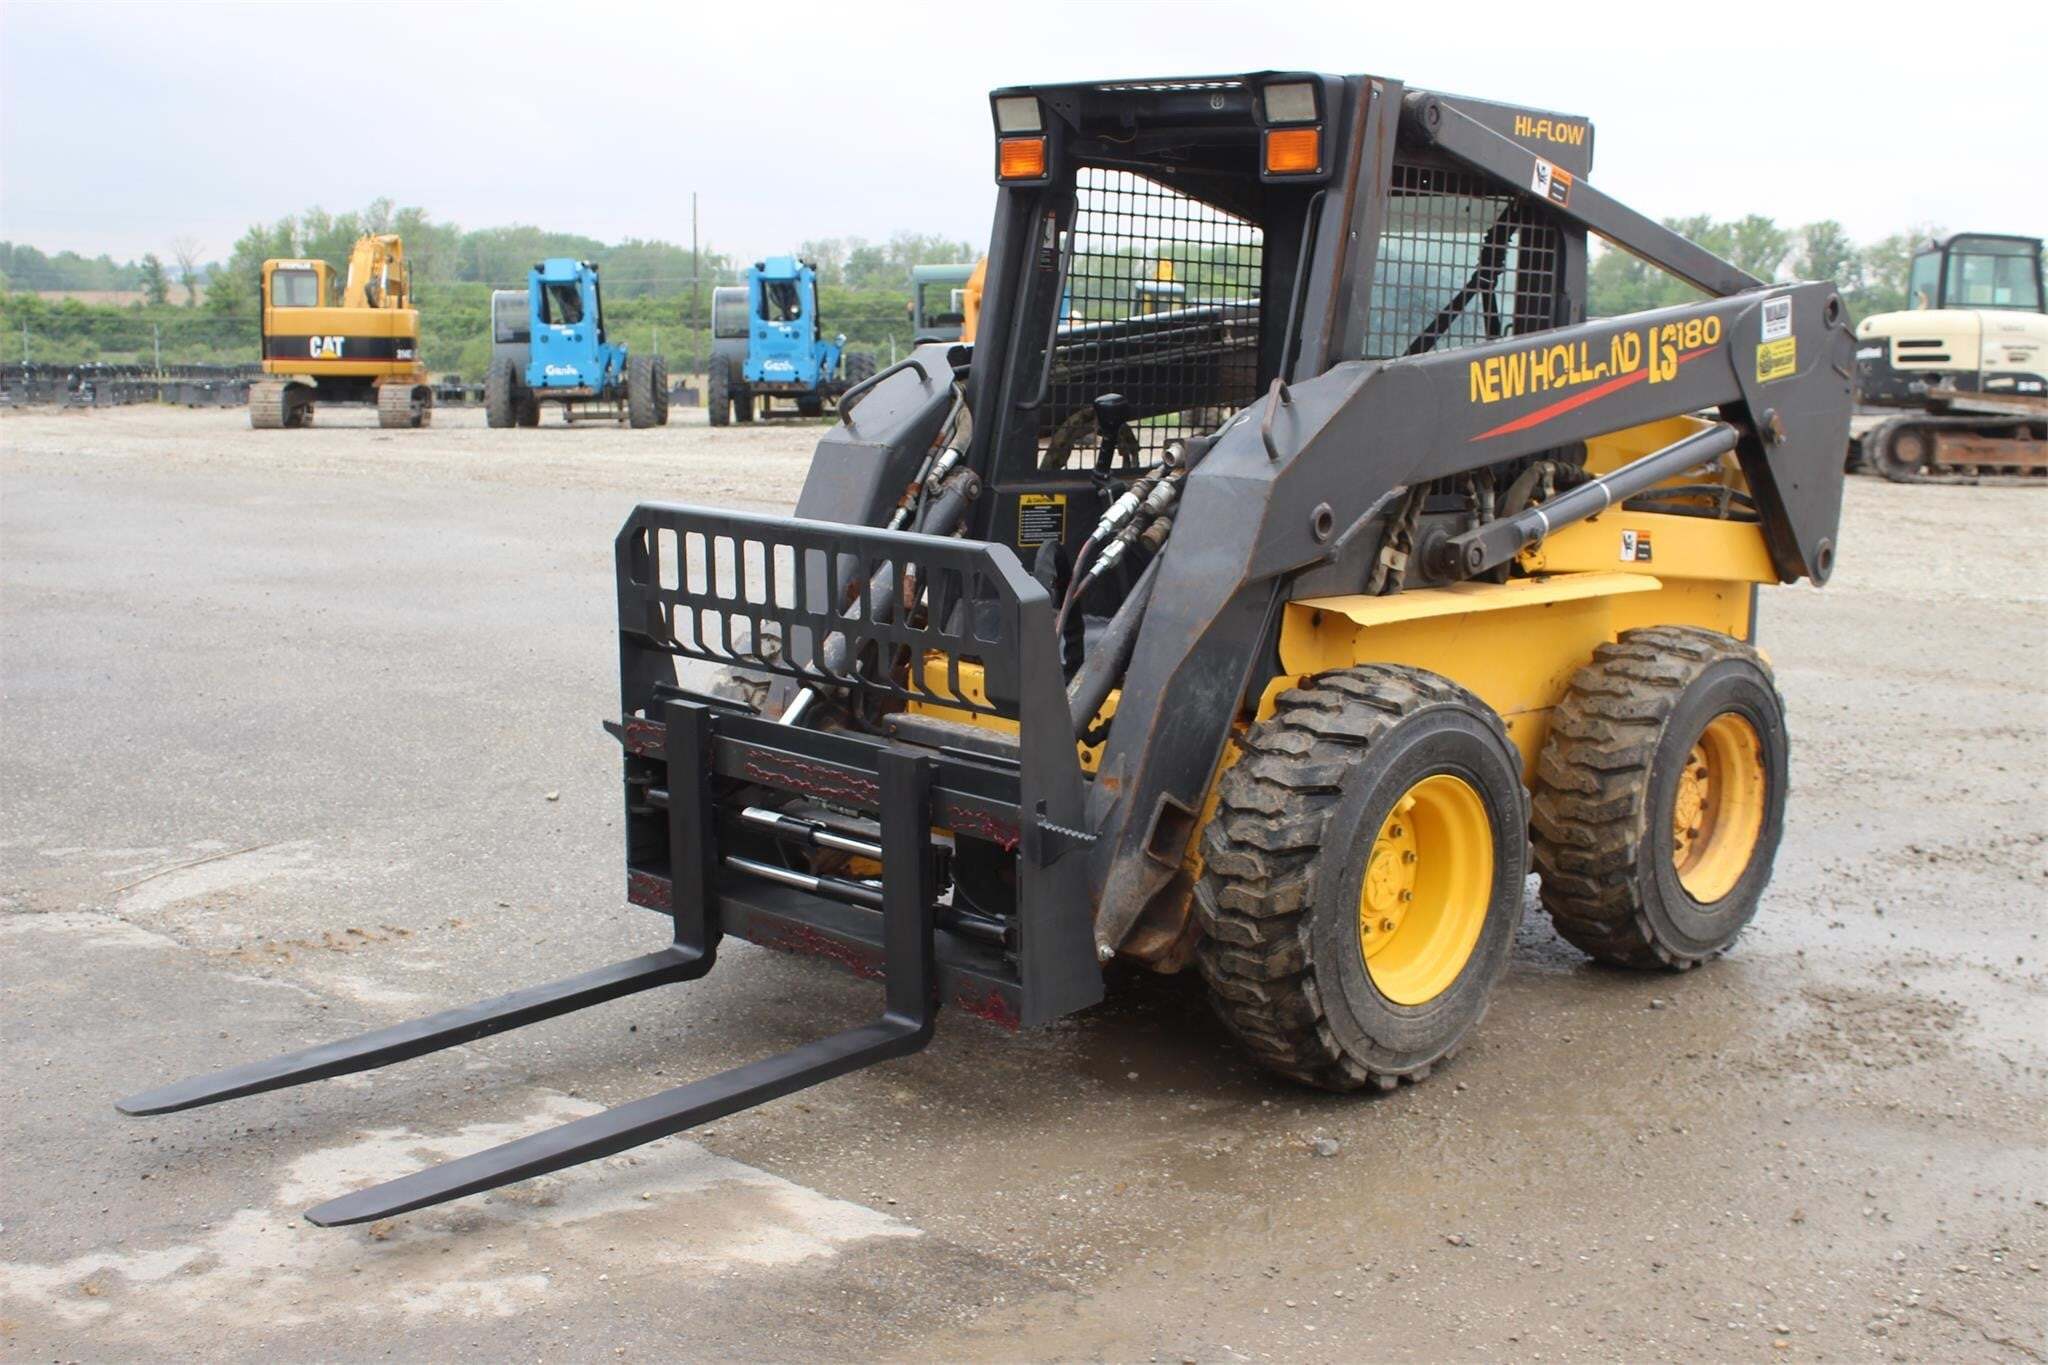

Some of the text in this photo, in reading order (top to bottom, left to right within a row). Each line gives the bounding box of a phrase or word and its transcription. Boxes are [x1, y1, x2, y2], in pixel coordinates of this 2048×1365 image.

[1514, 115, 1585, 145] HI-FLOW
[309, 336, 345, 359] CAT
[1470, 351, 1527, 403] NEW
